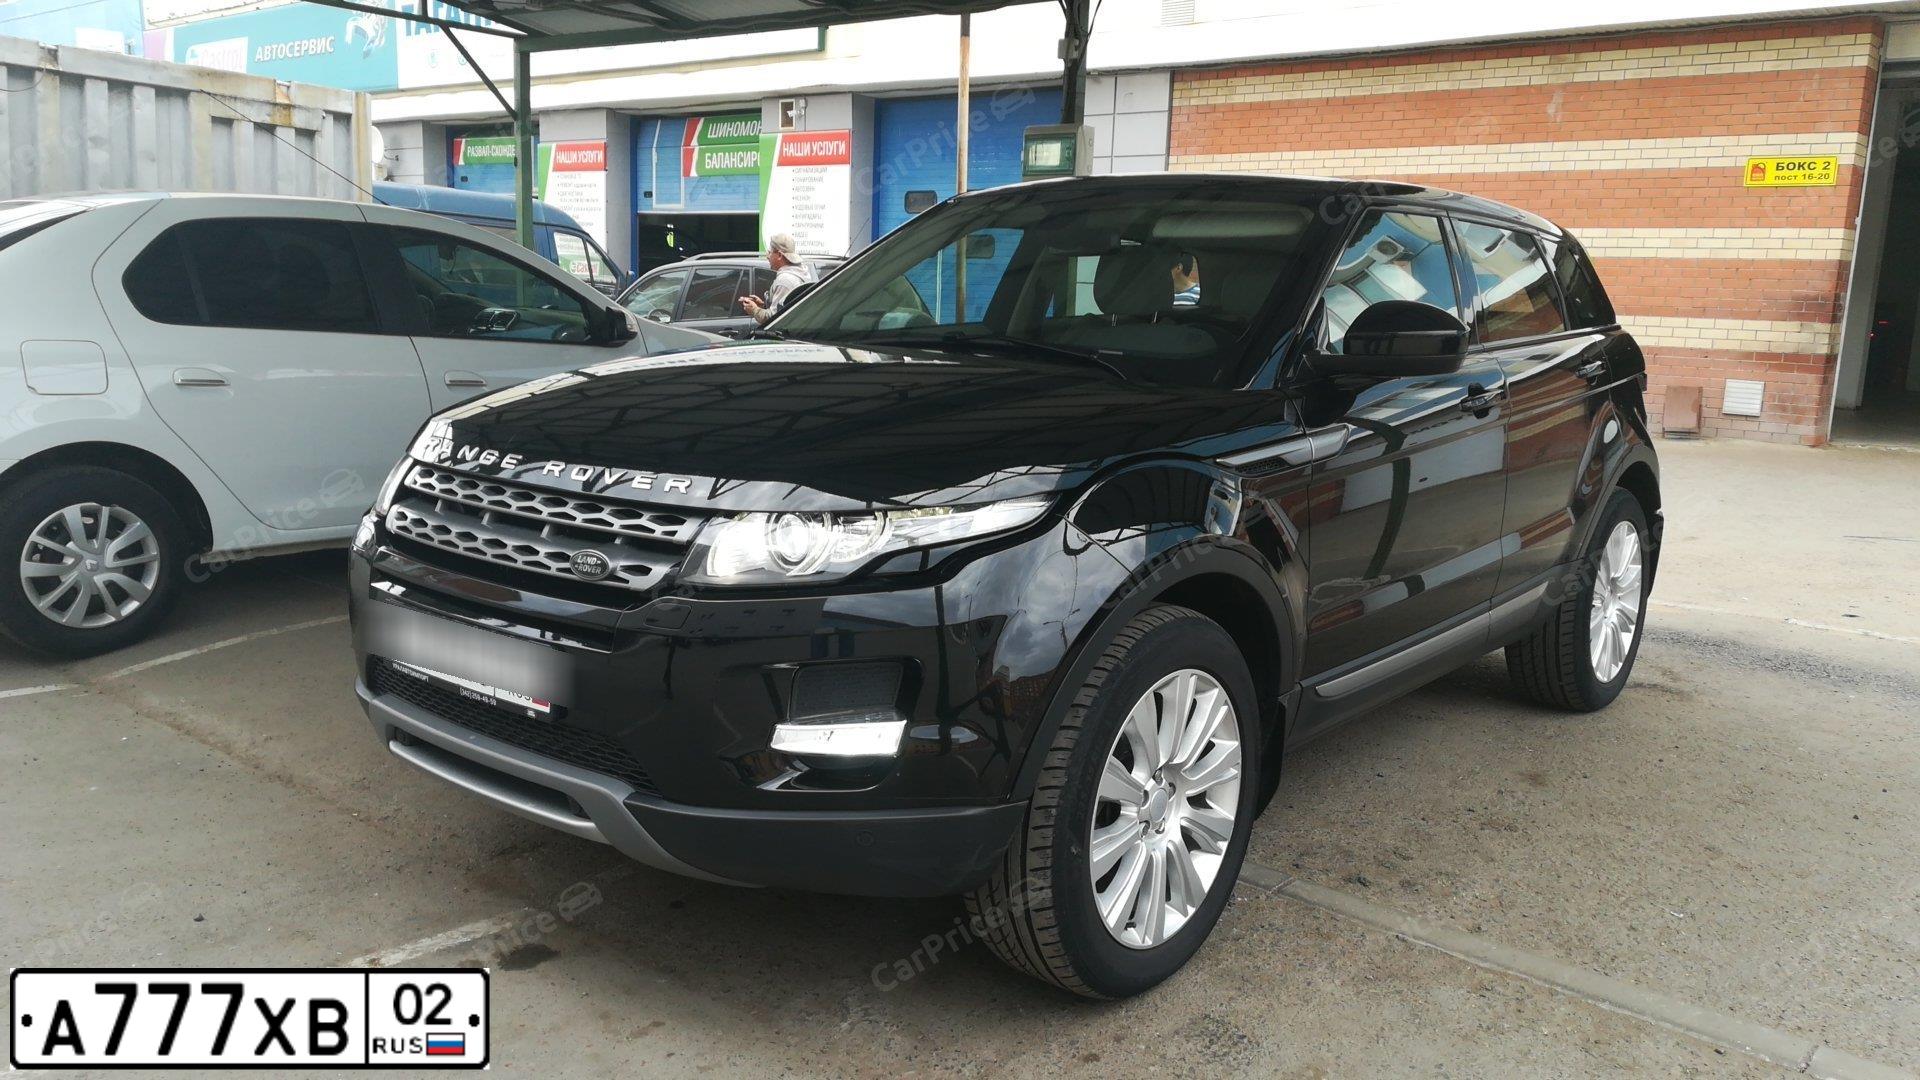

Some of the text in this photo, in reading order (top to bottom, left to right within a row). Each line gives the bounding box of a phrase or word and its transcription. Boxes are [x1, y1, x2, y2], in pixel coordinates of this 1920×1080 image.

[255, 36, 334, 63] АВТОСЕРВИС
[556, 149, 603, 164] НАШИ УСЛУГИ
[783, 140, 846, 157] НАШИ УСЛУГИ
[1775, 161, 1831, 171] БОКС 2
[541, 459, 694, 495] ROVER
